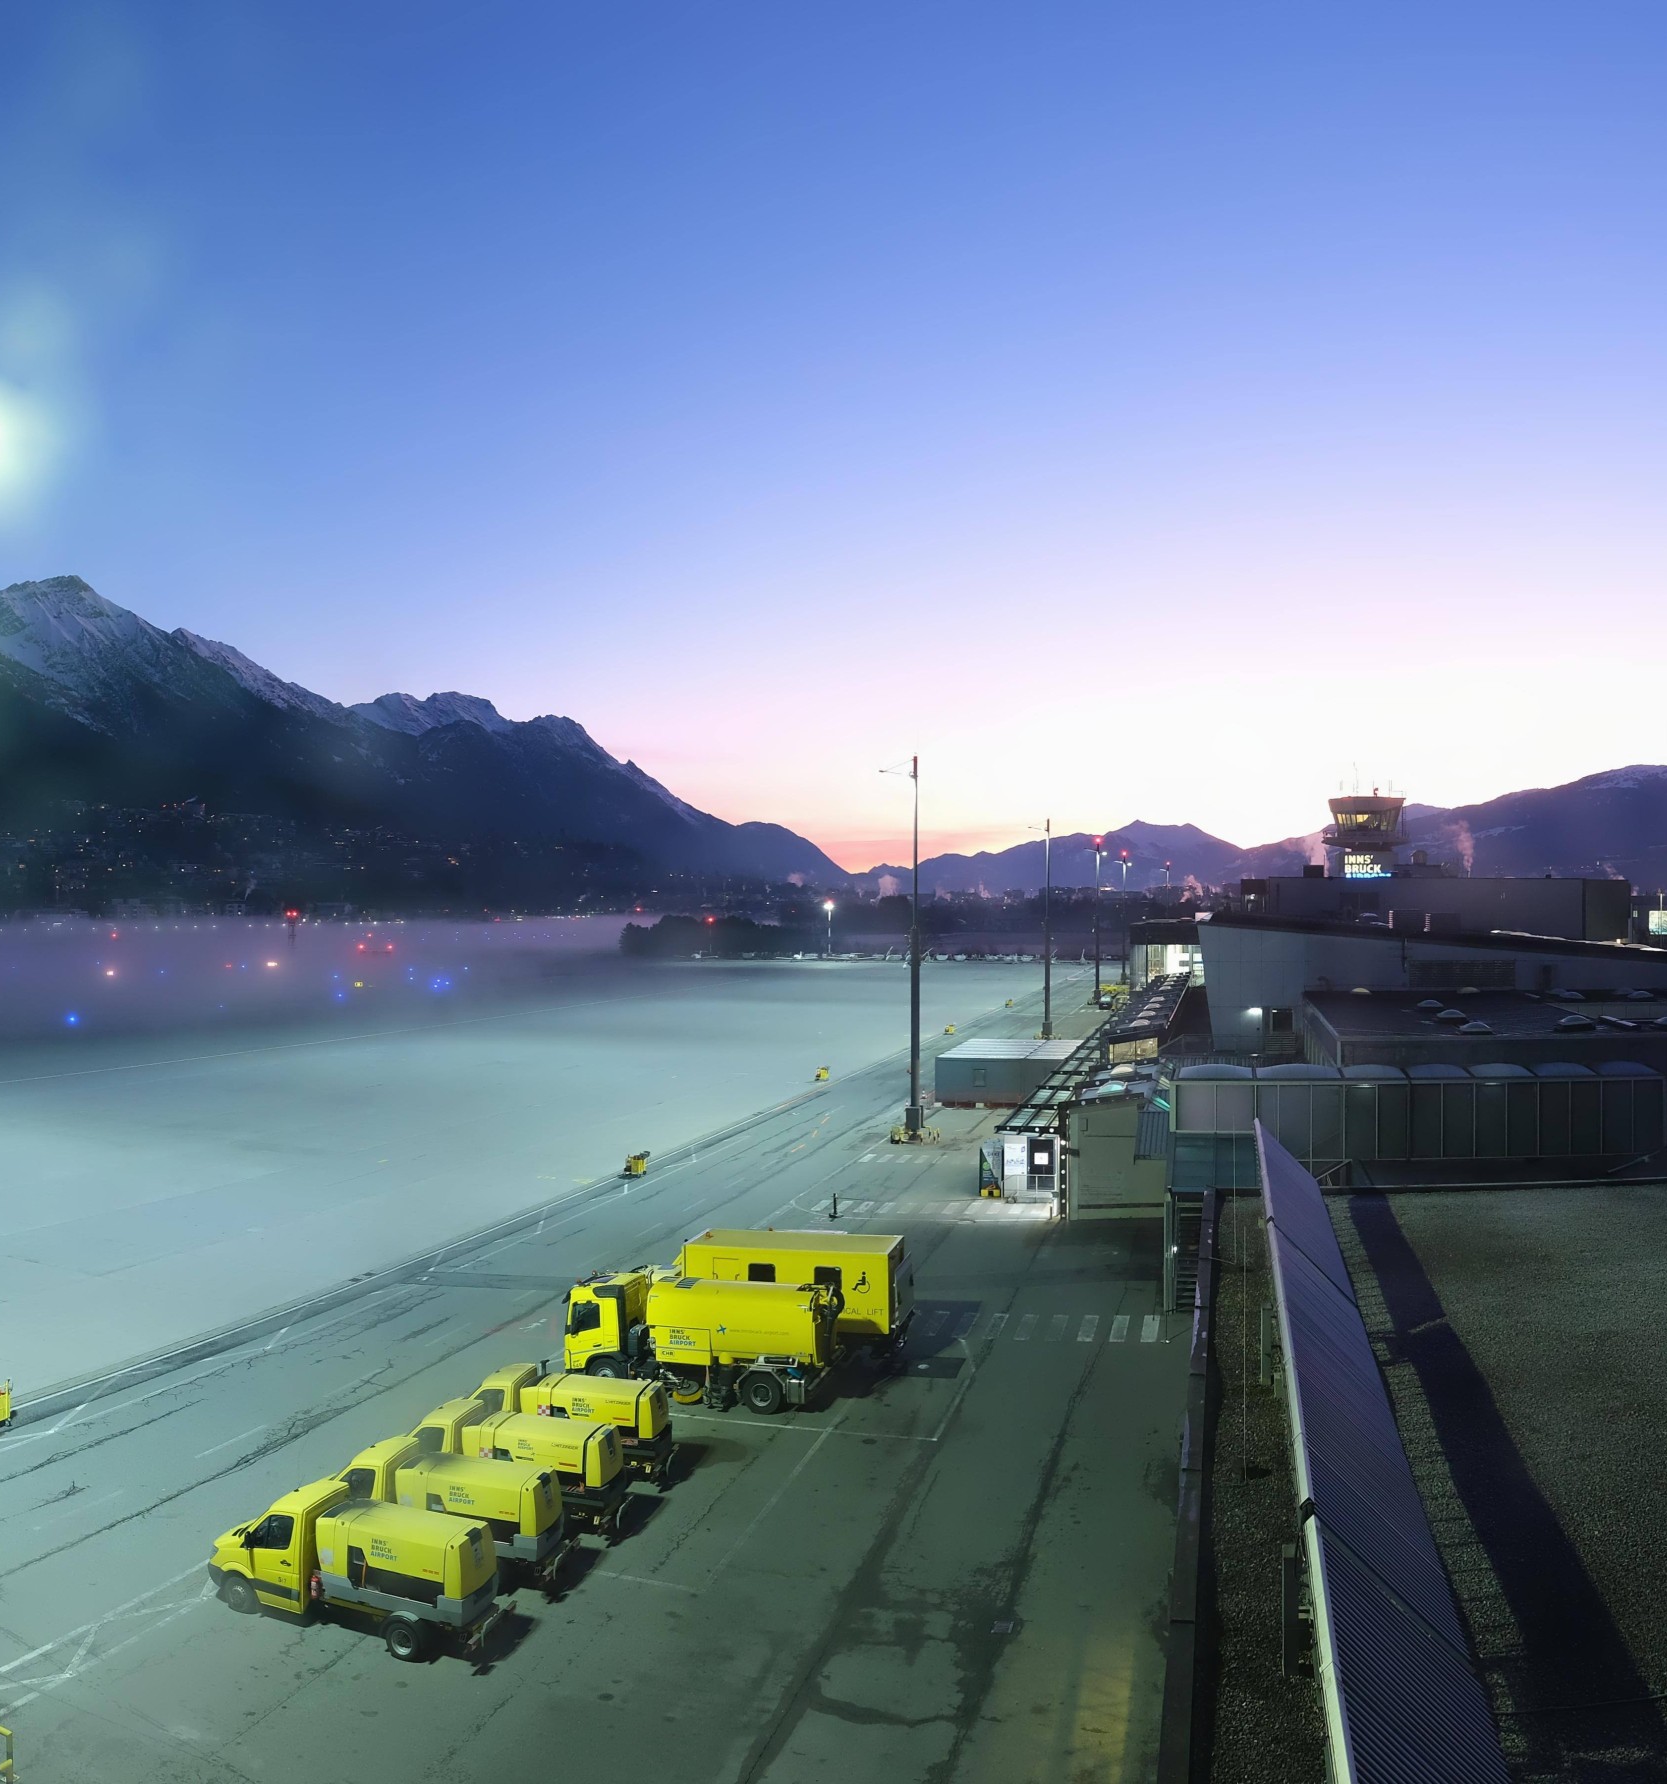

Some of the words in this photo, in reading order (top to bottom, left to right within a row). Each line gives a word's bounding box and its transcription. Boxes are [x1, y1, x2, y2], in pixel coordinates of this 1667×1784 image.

[1344, 855, 1374, 864] INNS'
[1344, 864, 1382, 873] BRUCK
[867, 1308, 885, 1316] LIFT
[449, 1491, 470, 1499] BRUCK
[449, 1497, 475, 1505] AIRPORT
[371, 1545, 393, 1554] BRUCK
[370, 1551, 398, 1562] AIRPORT
